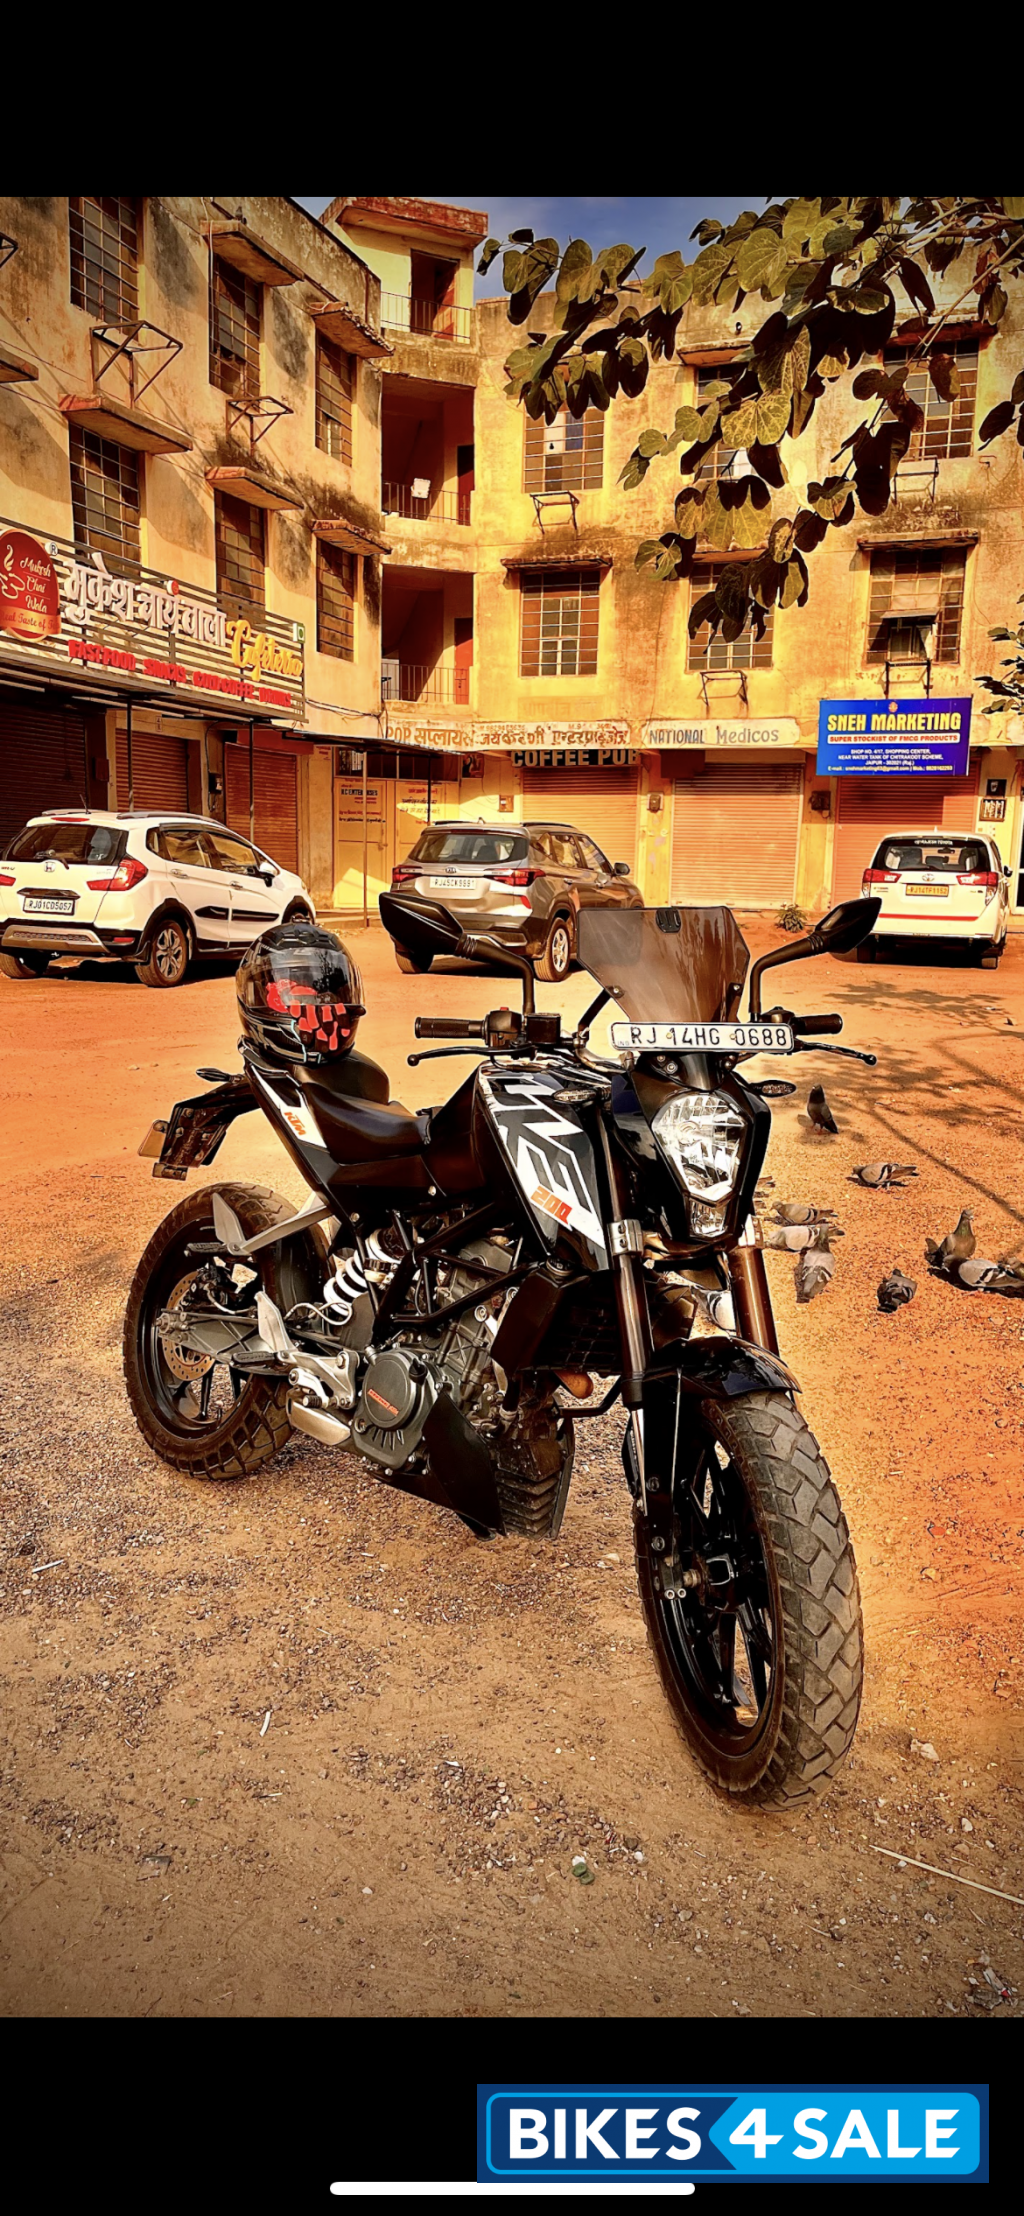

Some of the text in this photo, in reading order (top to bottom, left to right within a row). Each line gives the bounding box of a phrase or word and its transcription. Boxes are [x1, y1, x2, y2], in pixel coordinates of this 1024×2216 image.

[26, 575, 47, 594] Chai
[63, 552, 136, 625] मुकेश
[25, 595, 48, 613] Wala
[18, 613, 38, 627] Taste
[38, 619, 47, 632] of
[226, 620, 304, 681] Cafeteria
[827, 712, 962, 732] SNEH MARKETING
[649, 727, 779, 744] NATIONAL Medicos
[829, 735, 852, 743] SUPER
[920, 734, 958, 742] PRODUCTS
[511, 749, 638, 767] COFFEE PUB
[630, 1026, 787, 1046] RJ 14HG 0688
[284, 1111, 307, 1136] KTM
[530, 1185, 573, 1226] 200
